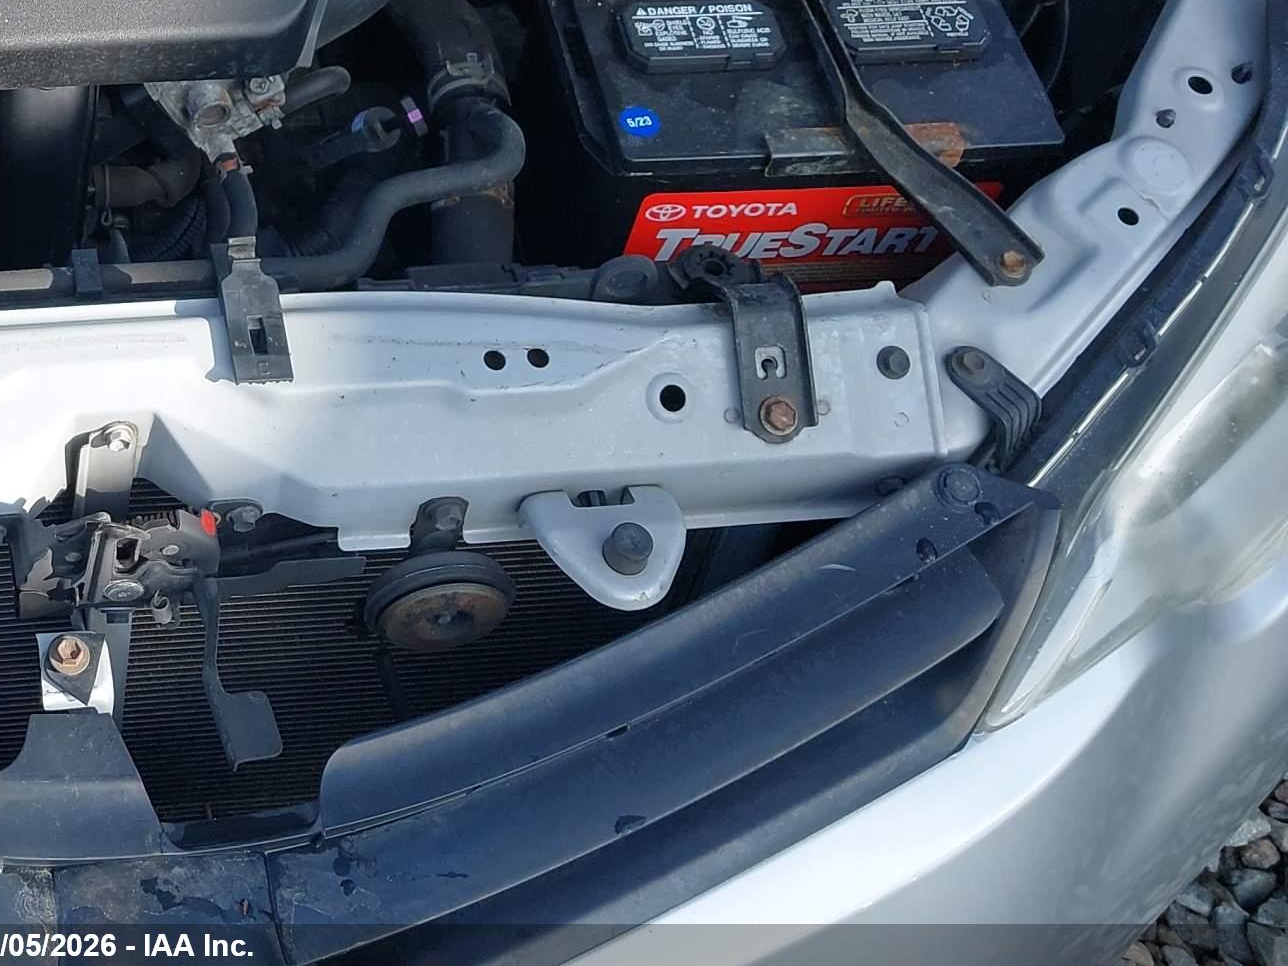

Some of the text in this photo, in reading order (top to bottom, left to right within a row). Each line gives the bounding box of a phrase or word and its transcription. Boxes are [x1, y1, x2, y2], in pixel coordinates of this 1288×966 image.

[647, 6, 697, 16] DANGER
[708, 4, 752, 13] POISON
[626, 115, 652, 128] 5/23
[692, 202, 798, 219] TOYOTA
